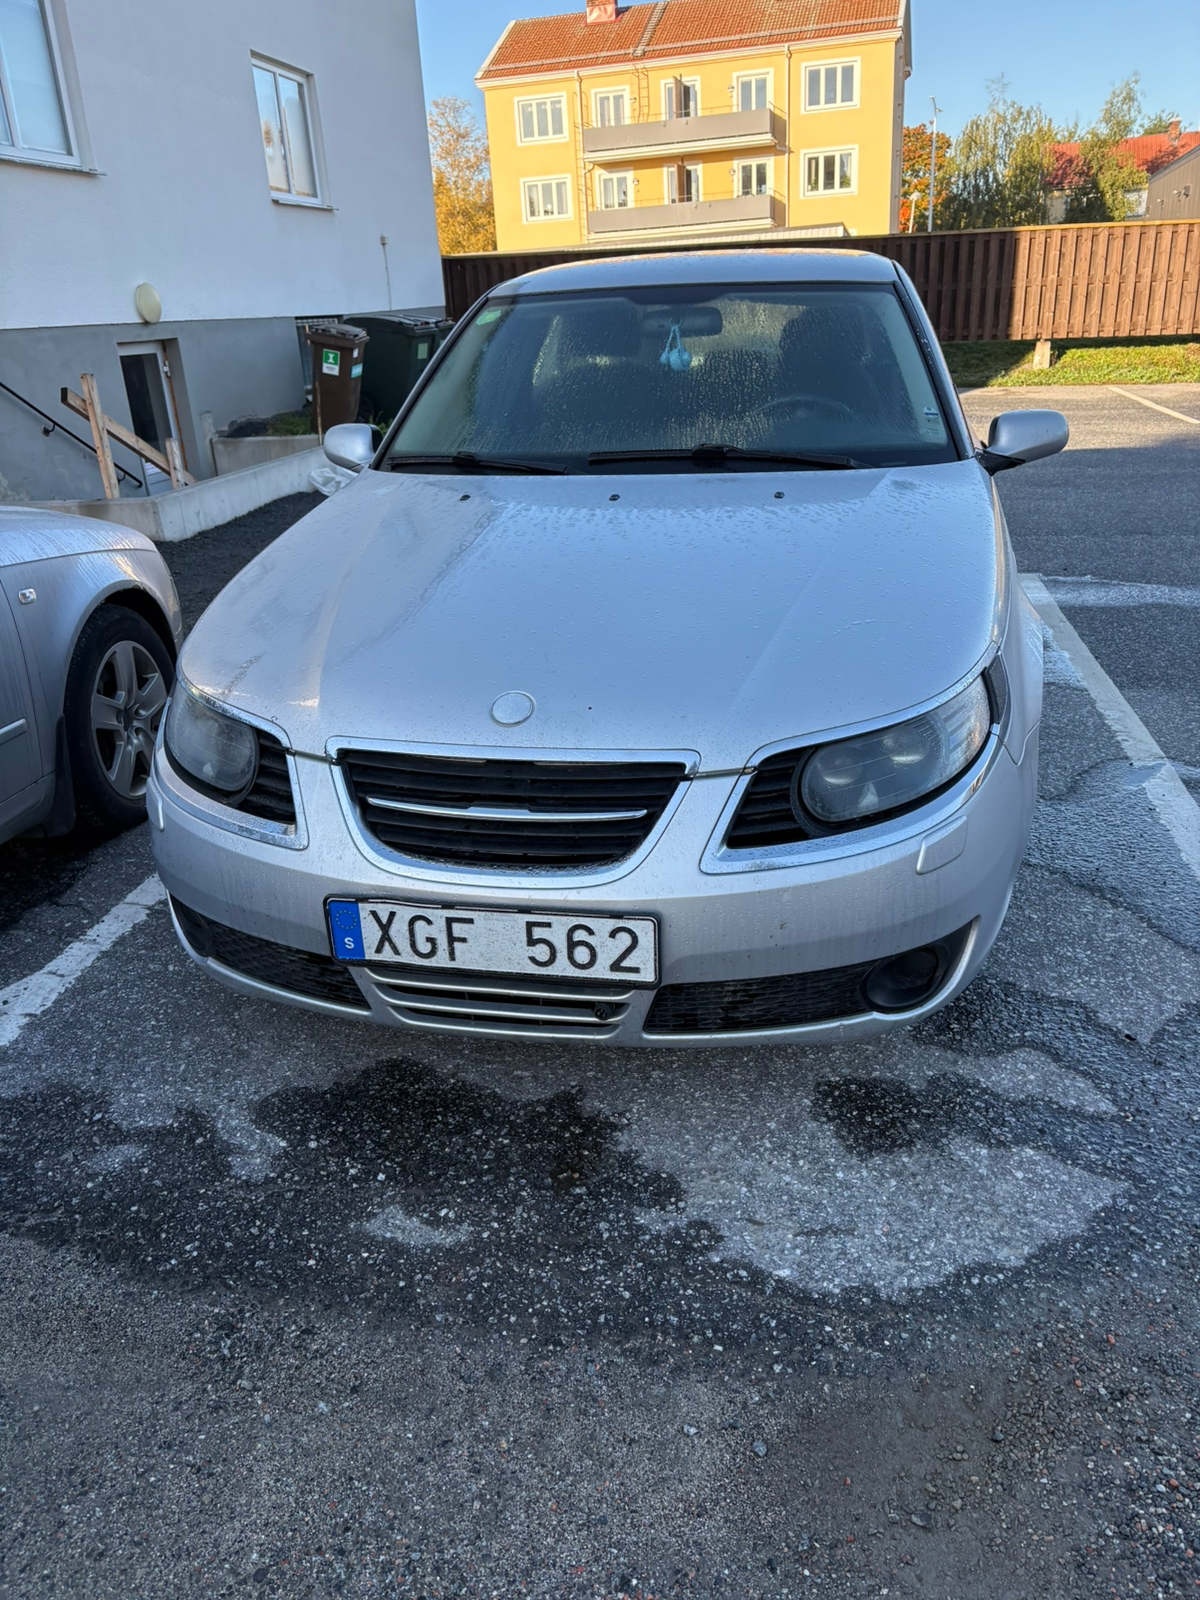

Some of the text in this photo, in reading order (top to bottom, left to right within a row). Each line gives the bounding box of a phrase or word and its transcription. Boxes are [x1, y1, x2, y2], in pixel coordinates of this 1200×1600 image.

[343, 936, 355, 950] S
[369, 910, 641, 974] XGF 562
